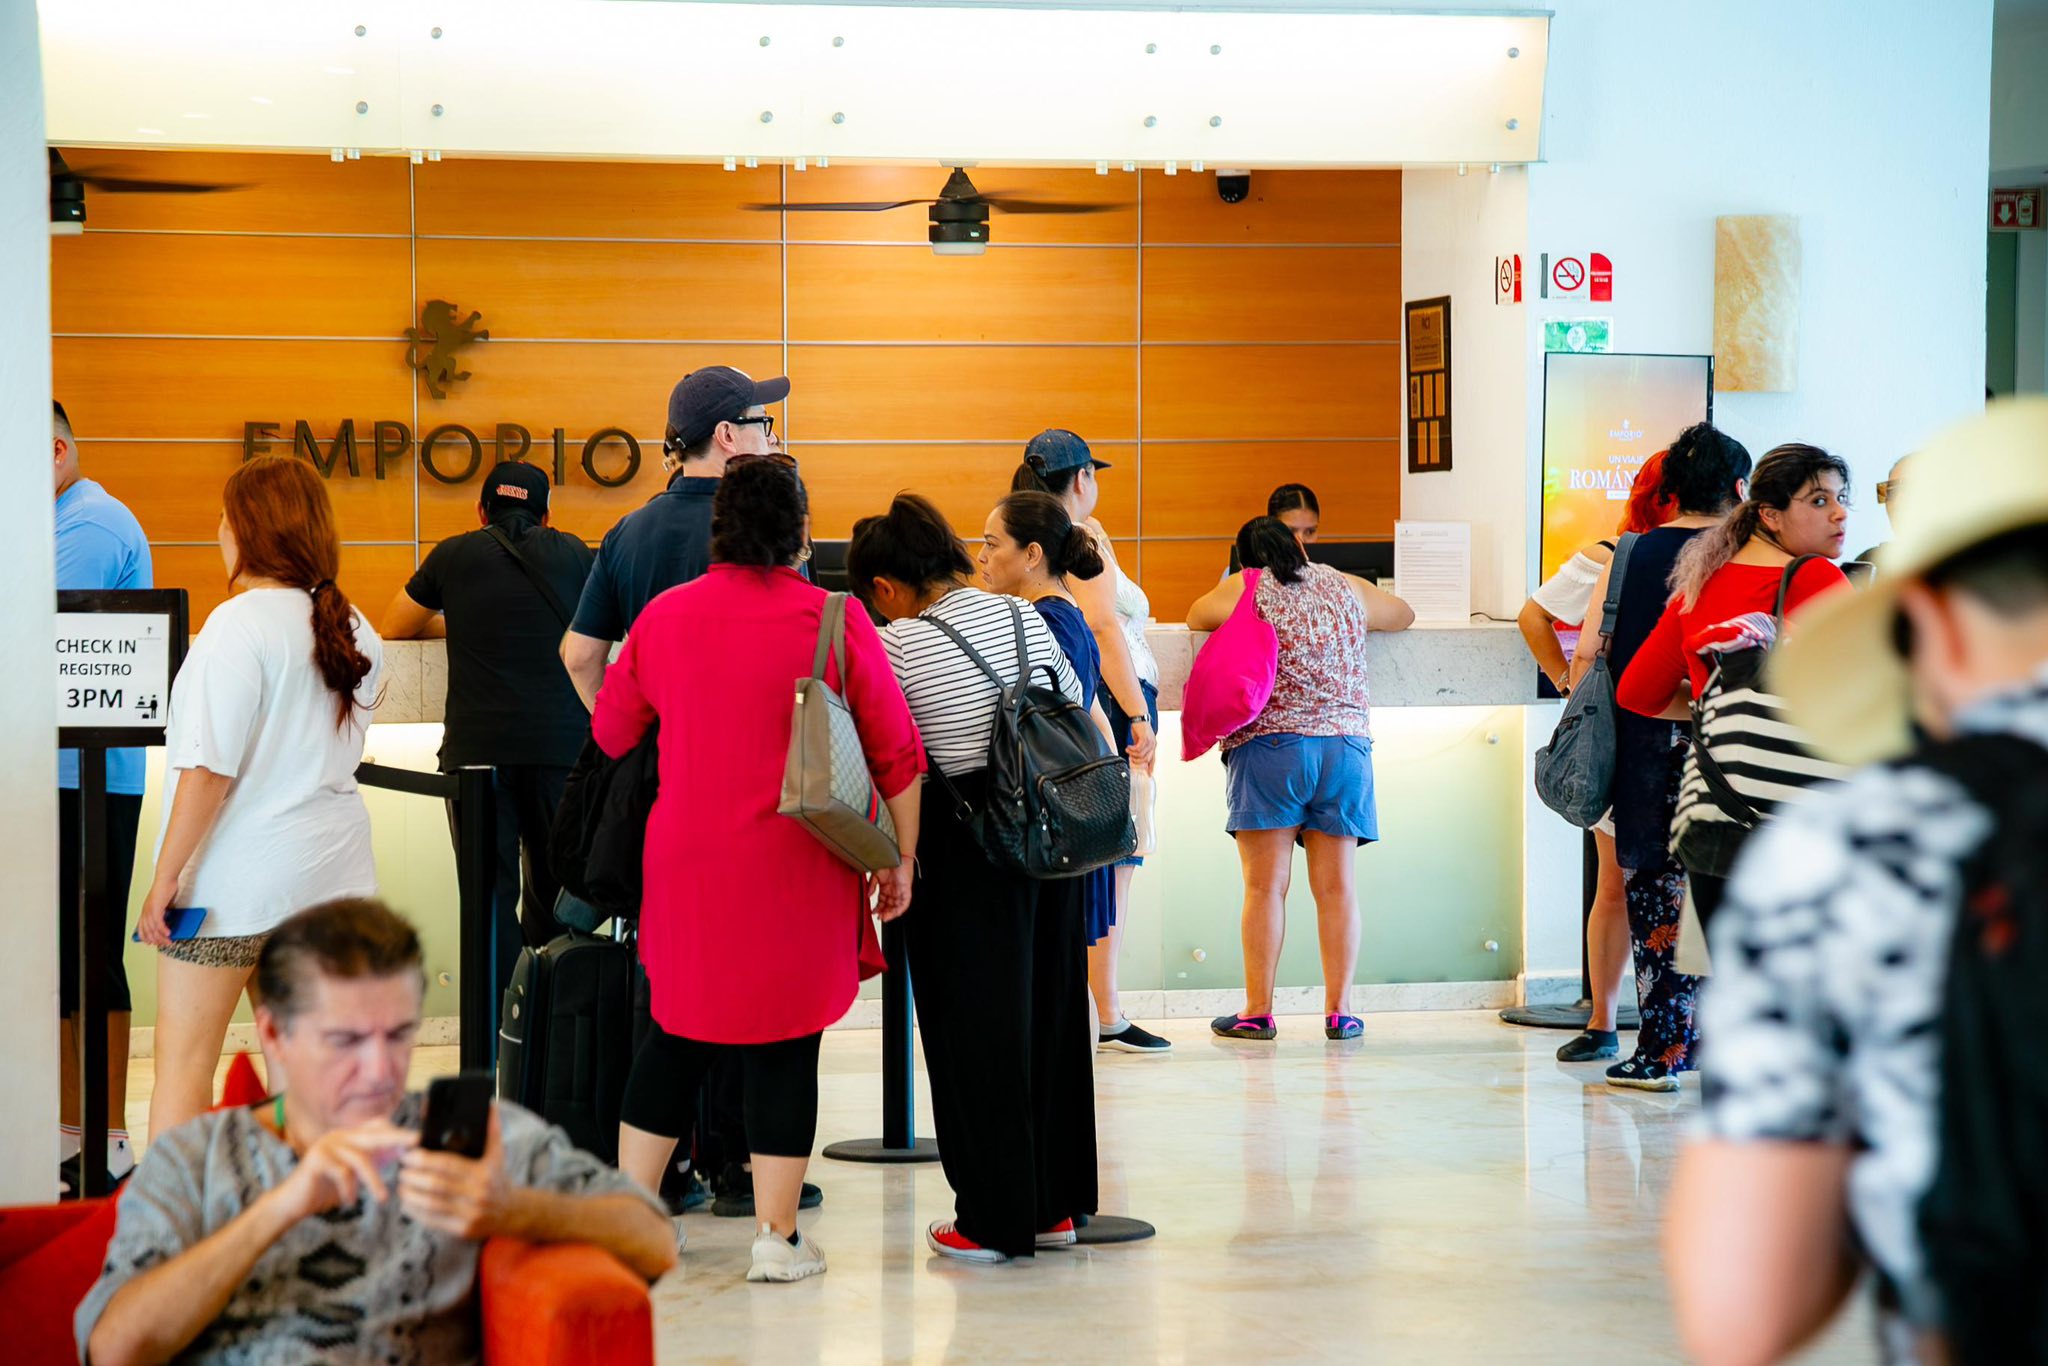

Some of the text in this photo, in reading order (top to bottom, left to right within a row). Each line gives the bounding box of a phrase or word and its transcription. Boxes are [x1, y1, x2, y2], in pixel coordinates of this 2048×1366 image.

[243, 418, 641, 488] EMPORIO
[1608, 455, 1644, 465] UN VIAJE
[1569, 465, 1640, 489] ROMÁN
[56, 638, 136, 654] CHECK IN
[59, 663, 132, 676] REGISTRO
[66, 688, 123, 708] 3PM
